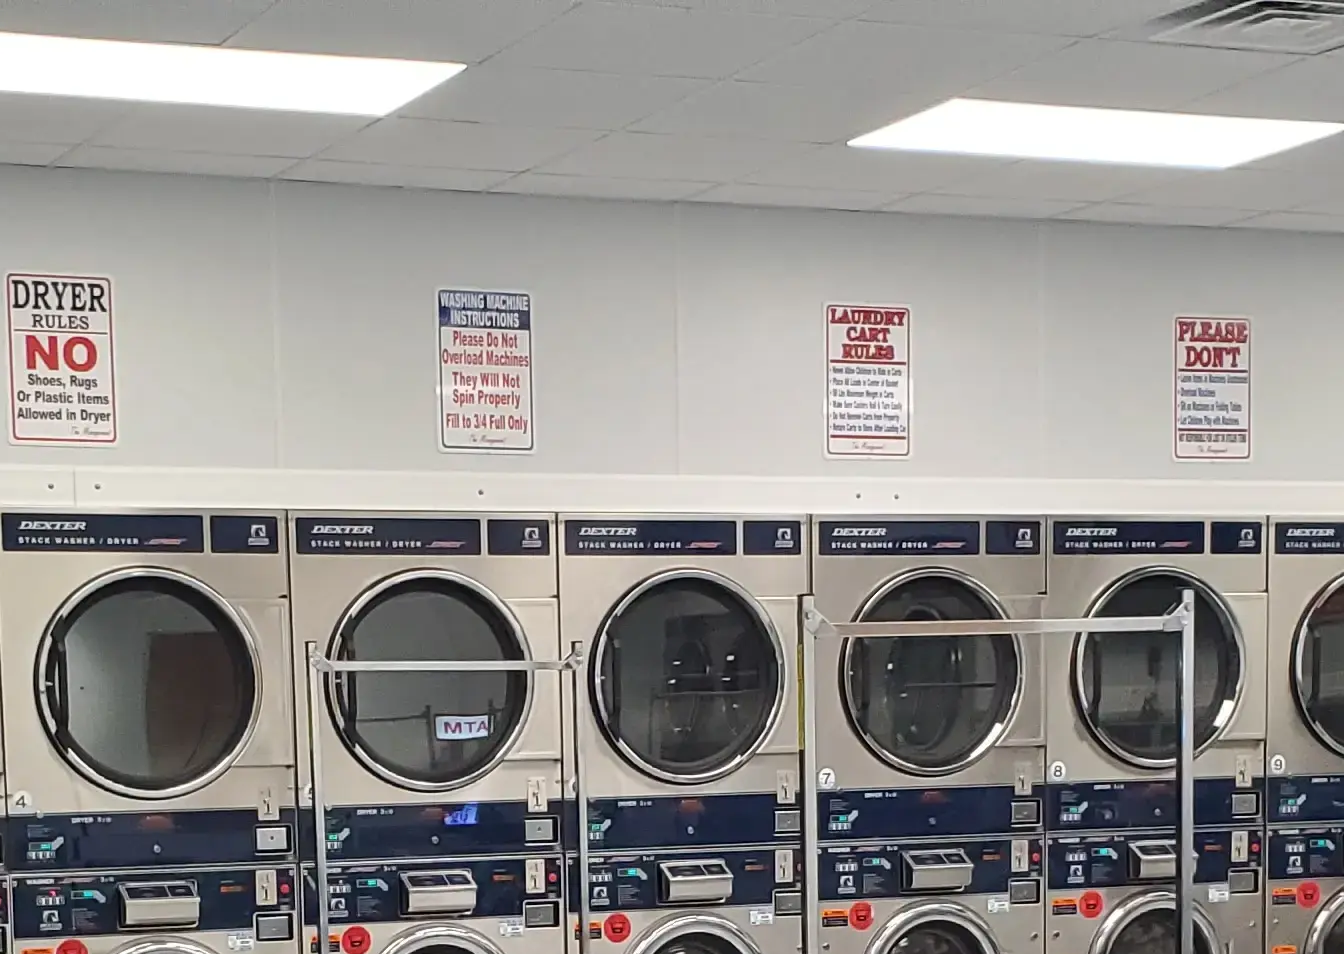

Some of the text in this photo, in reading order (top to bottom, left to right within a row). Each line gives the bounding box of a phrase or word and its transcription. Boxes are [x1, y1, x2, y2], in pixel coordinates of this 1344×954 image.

[12, 280, 107, 312] DRYER
[440, 292, 528, 310] WASHING MACHINE
[32, 314, 89, 330] RULES
[450, 310, 519, 328] INSTRUCTIONS
[830, 308, 906, 326] LAUNDRY
[452, 330, 518, 348] Please Do Not
[846, 326, 890, 343] CART
[1178, 320, 1248, 343] PLEASE
[25, 335, 98, 372] NO
[442, 348, 529, 367] Overload Machines
[842, 344, 894, 360] RULES
[1184, 346, 1241, 368] DON'T
[28, 374, 98, 390] Shoes, Rugs
[452, 372, 520, 390] They Will Not
[17, 390, 110, 405] Or Plastic Items
[452, 390, 520, 409] Spin Properly
[17, 408, 112, 424] Allowed in Dryer
[446, 413, 528, 434] Fill to 3/4 Full Only
[18, 521, 86, 530] DEXTER
[311, 526, 374, 534] DEXTER
[578, 527, 637, 536] DEXTER
[832, 528, 887, 536] DEXTER
[1066, 528, 1116, 536] DEXTER
[18, 537, 50, 545] STACK
[55, 537, 96, 545] WASHER
[107, 537, 138, 545] DRYER
[1053, 767, 1062, 778] 8
[1274, 759, 1282, 770] 9
[822, 773, 831, 784] 7
[16, 795, 26, 808] 4
